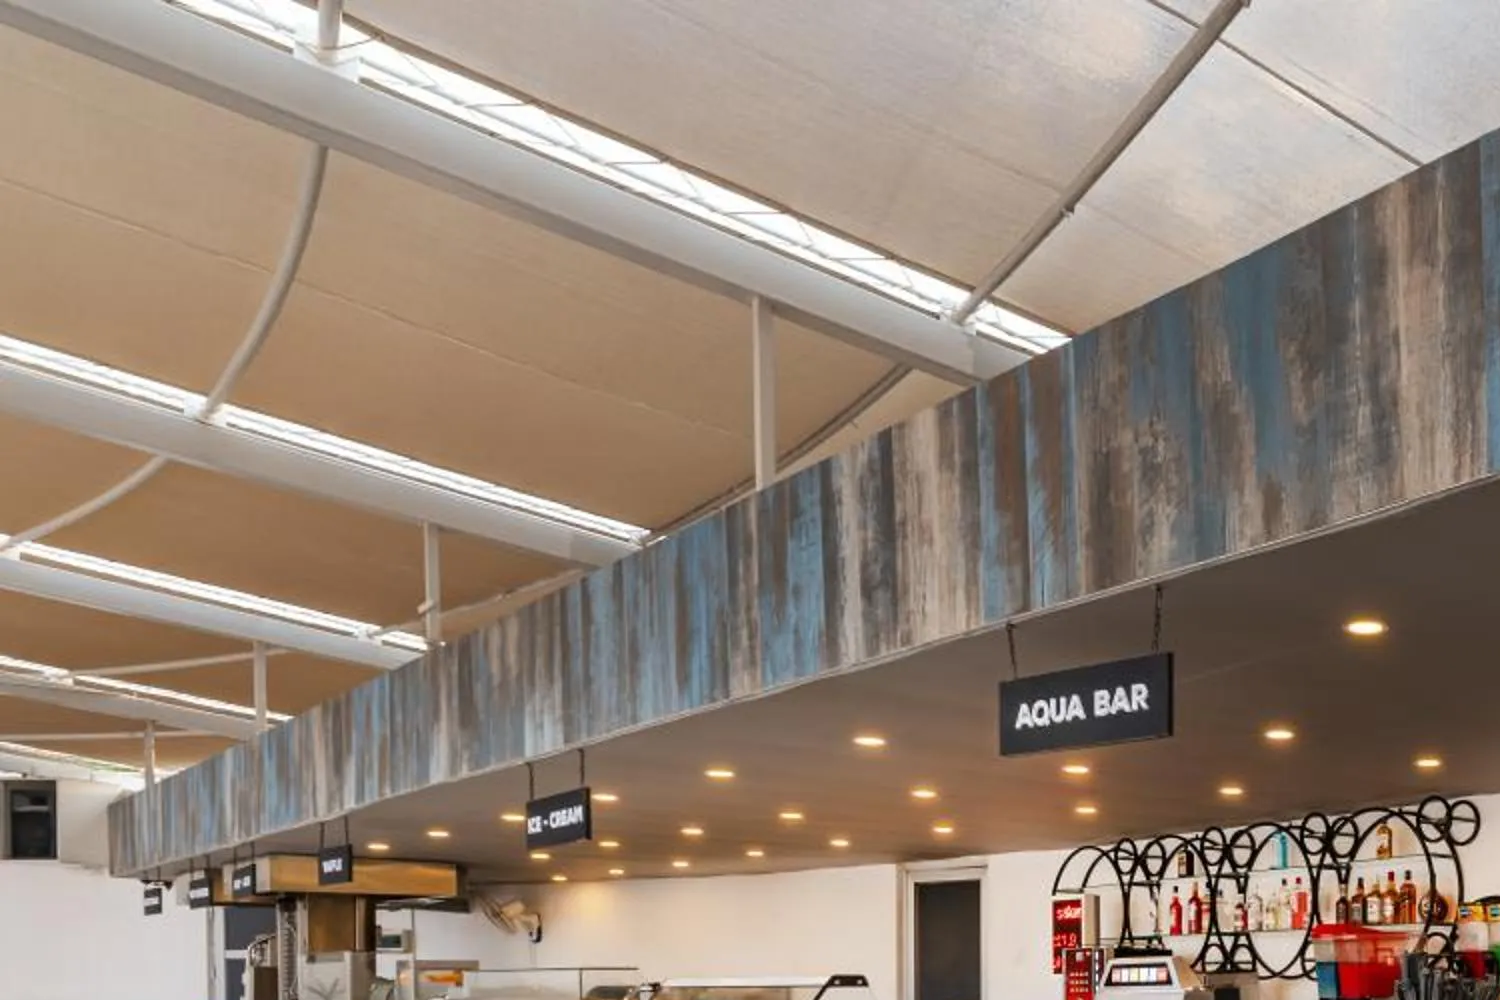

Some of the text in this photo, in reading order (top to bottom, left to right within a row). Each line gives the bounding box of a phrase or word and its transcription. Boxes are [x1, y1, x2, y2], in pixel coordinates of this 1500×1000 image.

[1015, 683, 1149, 730] AQUA BAR
[549, 805, 584, 828] CREAM
